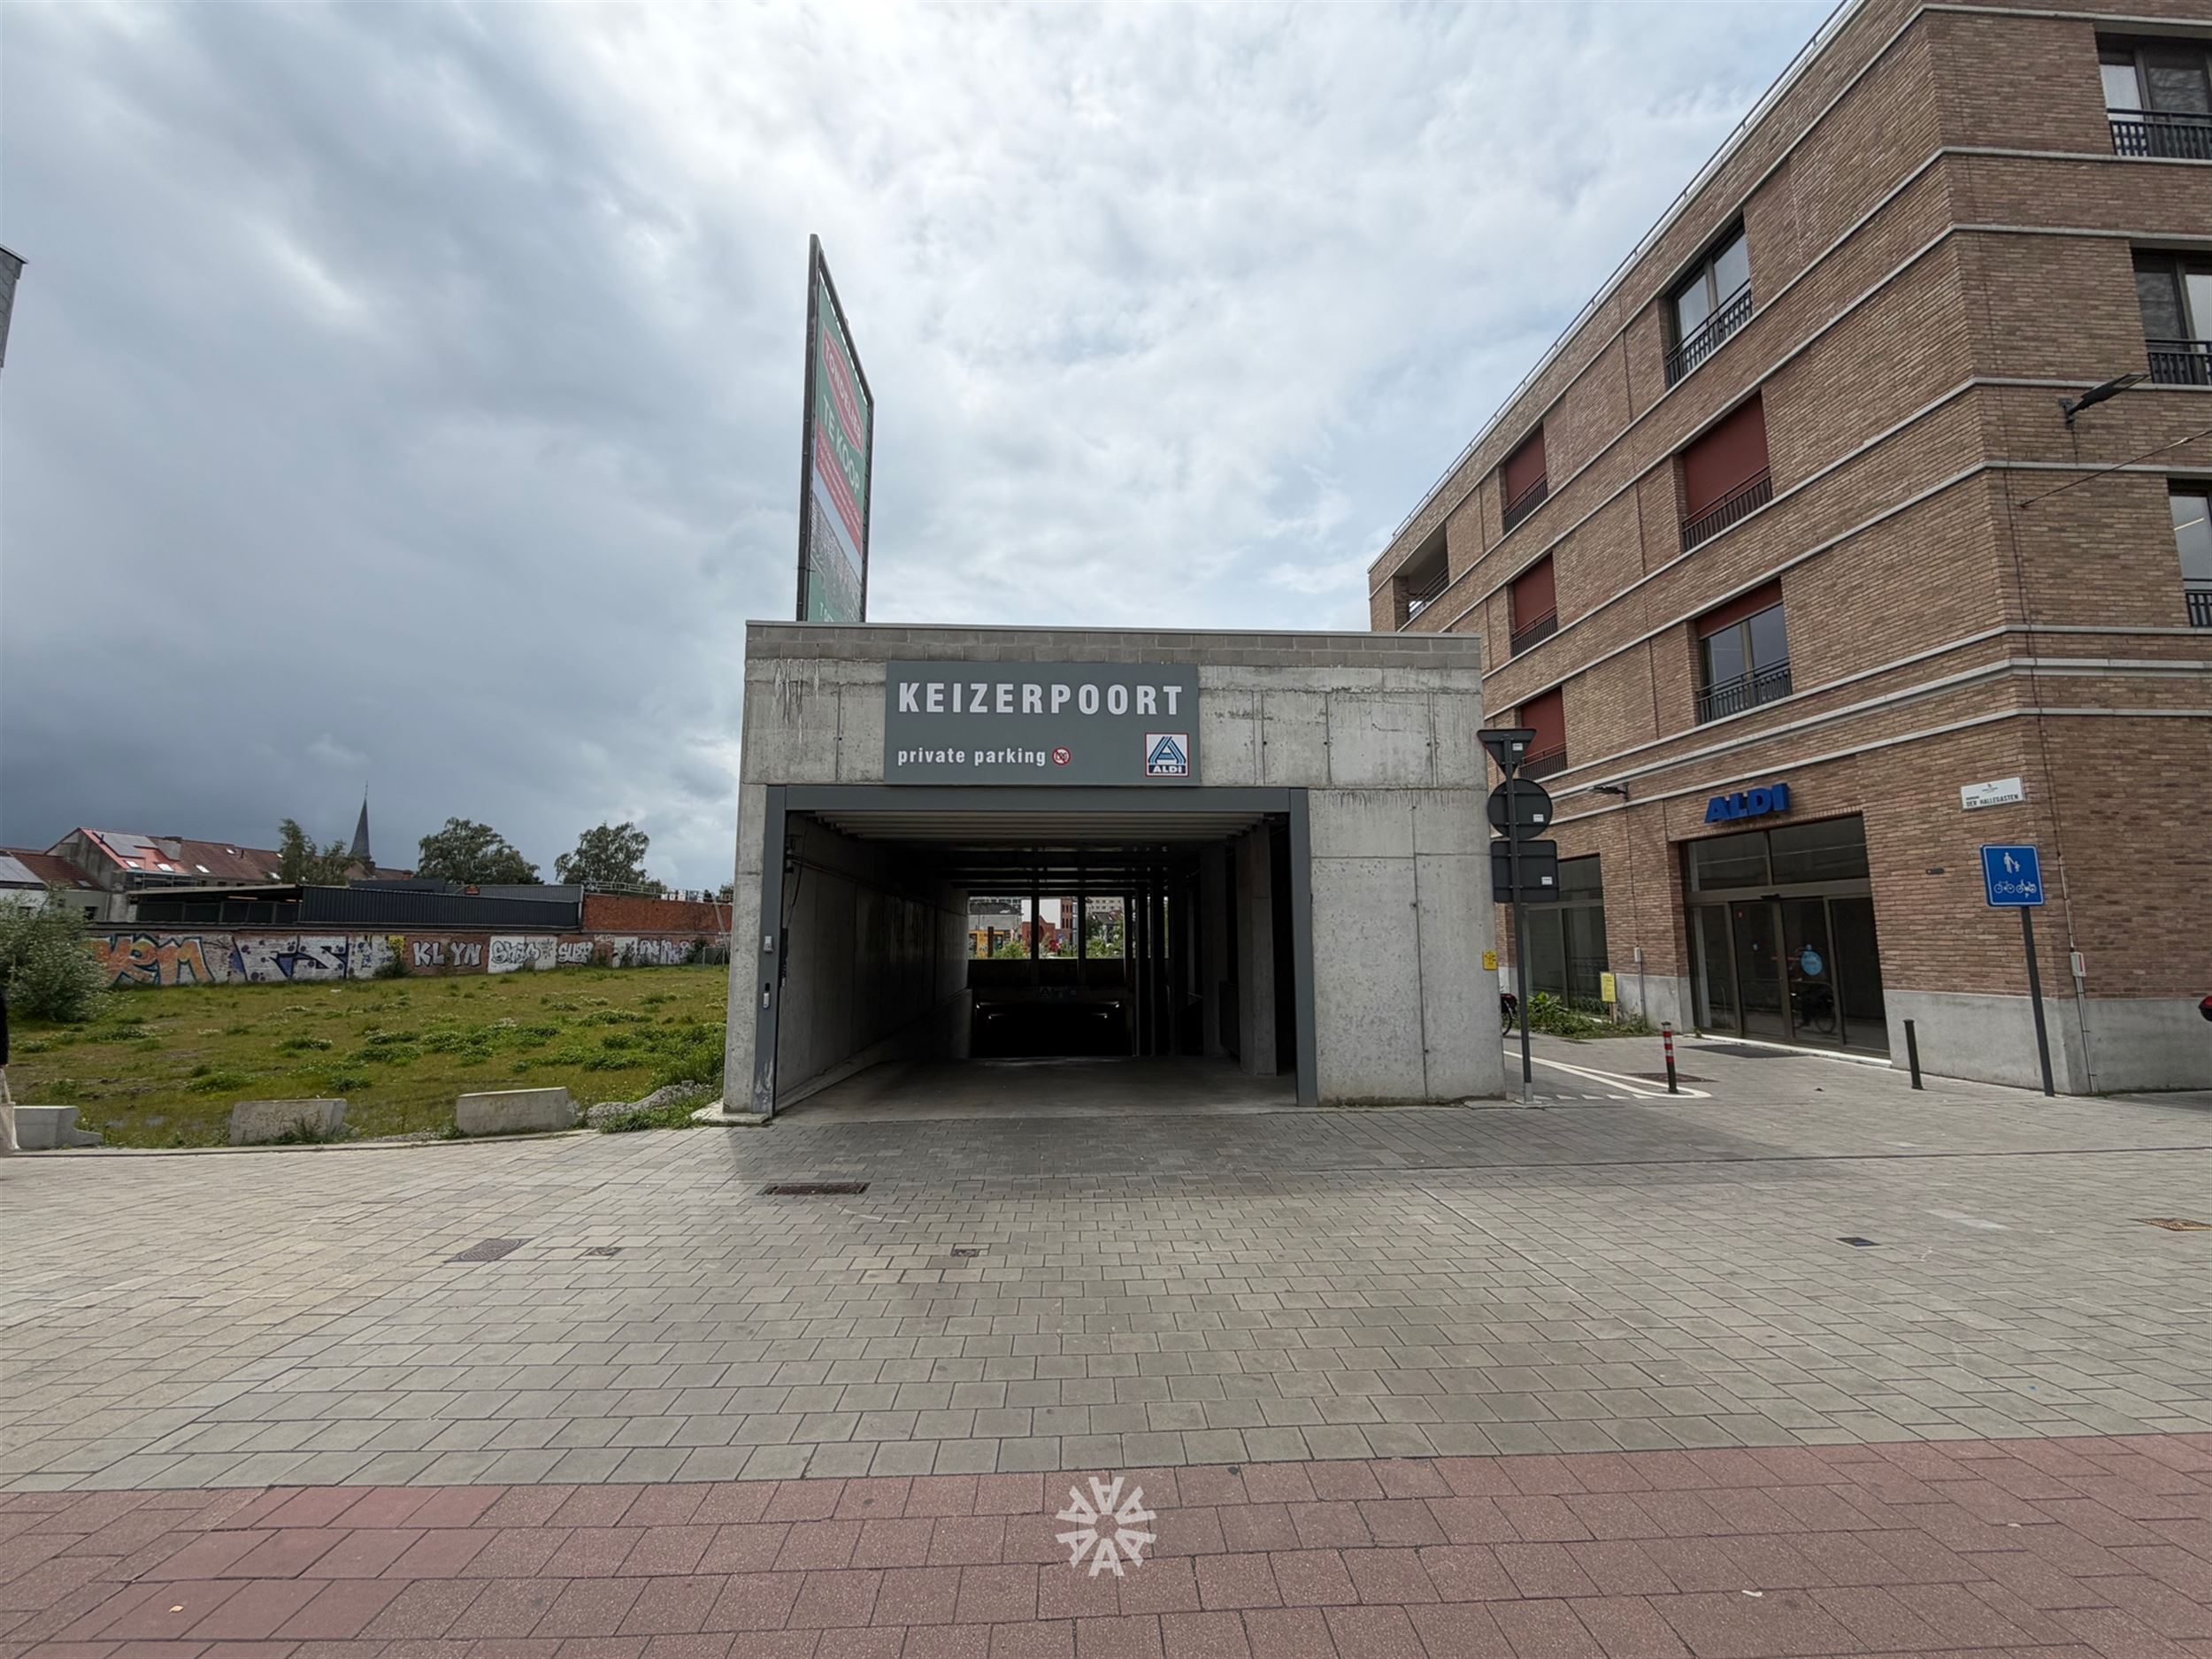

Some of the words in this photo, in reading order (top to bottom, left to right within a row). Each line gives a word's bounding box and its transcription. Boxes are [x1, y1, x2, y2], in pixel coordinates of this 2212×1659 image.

[823, 395, 834, 441] TE
[836, 426, 860, 494] KOOP
[899, 682, 1183, 715] KEIZERPOORT
[897, 747, 965, 766] private
[974, 748, 1046, 767] parking
[1704, 783, 1789, 823] ALDI
